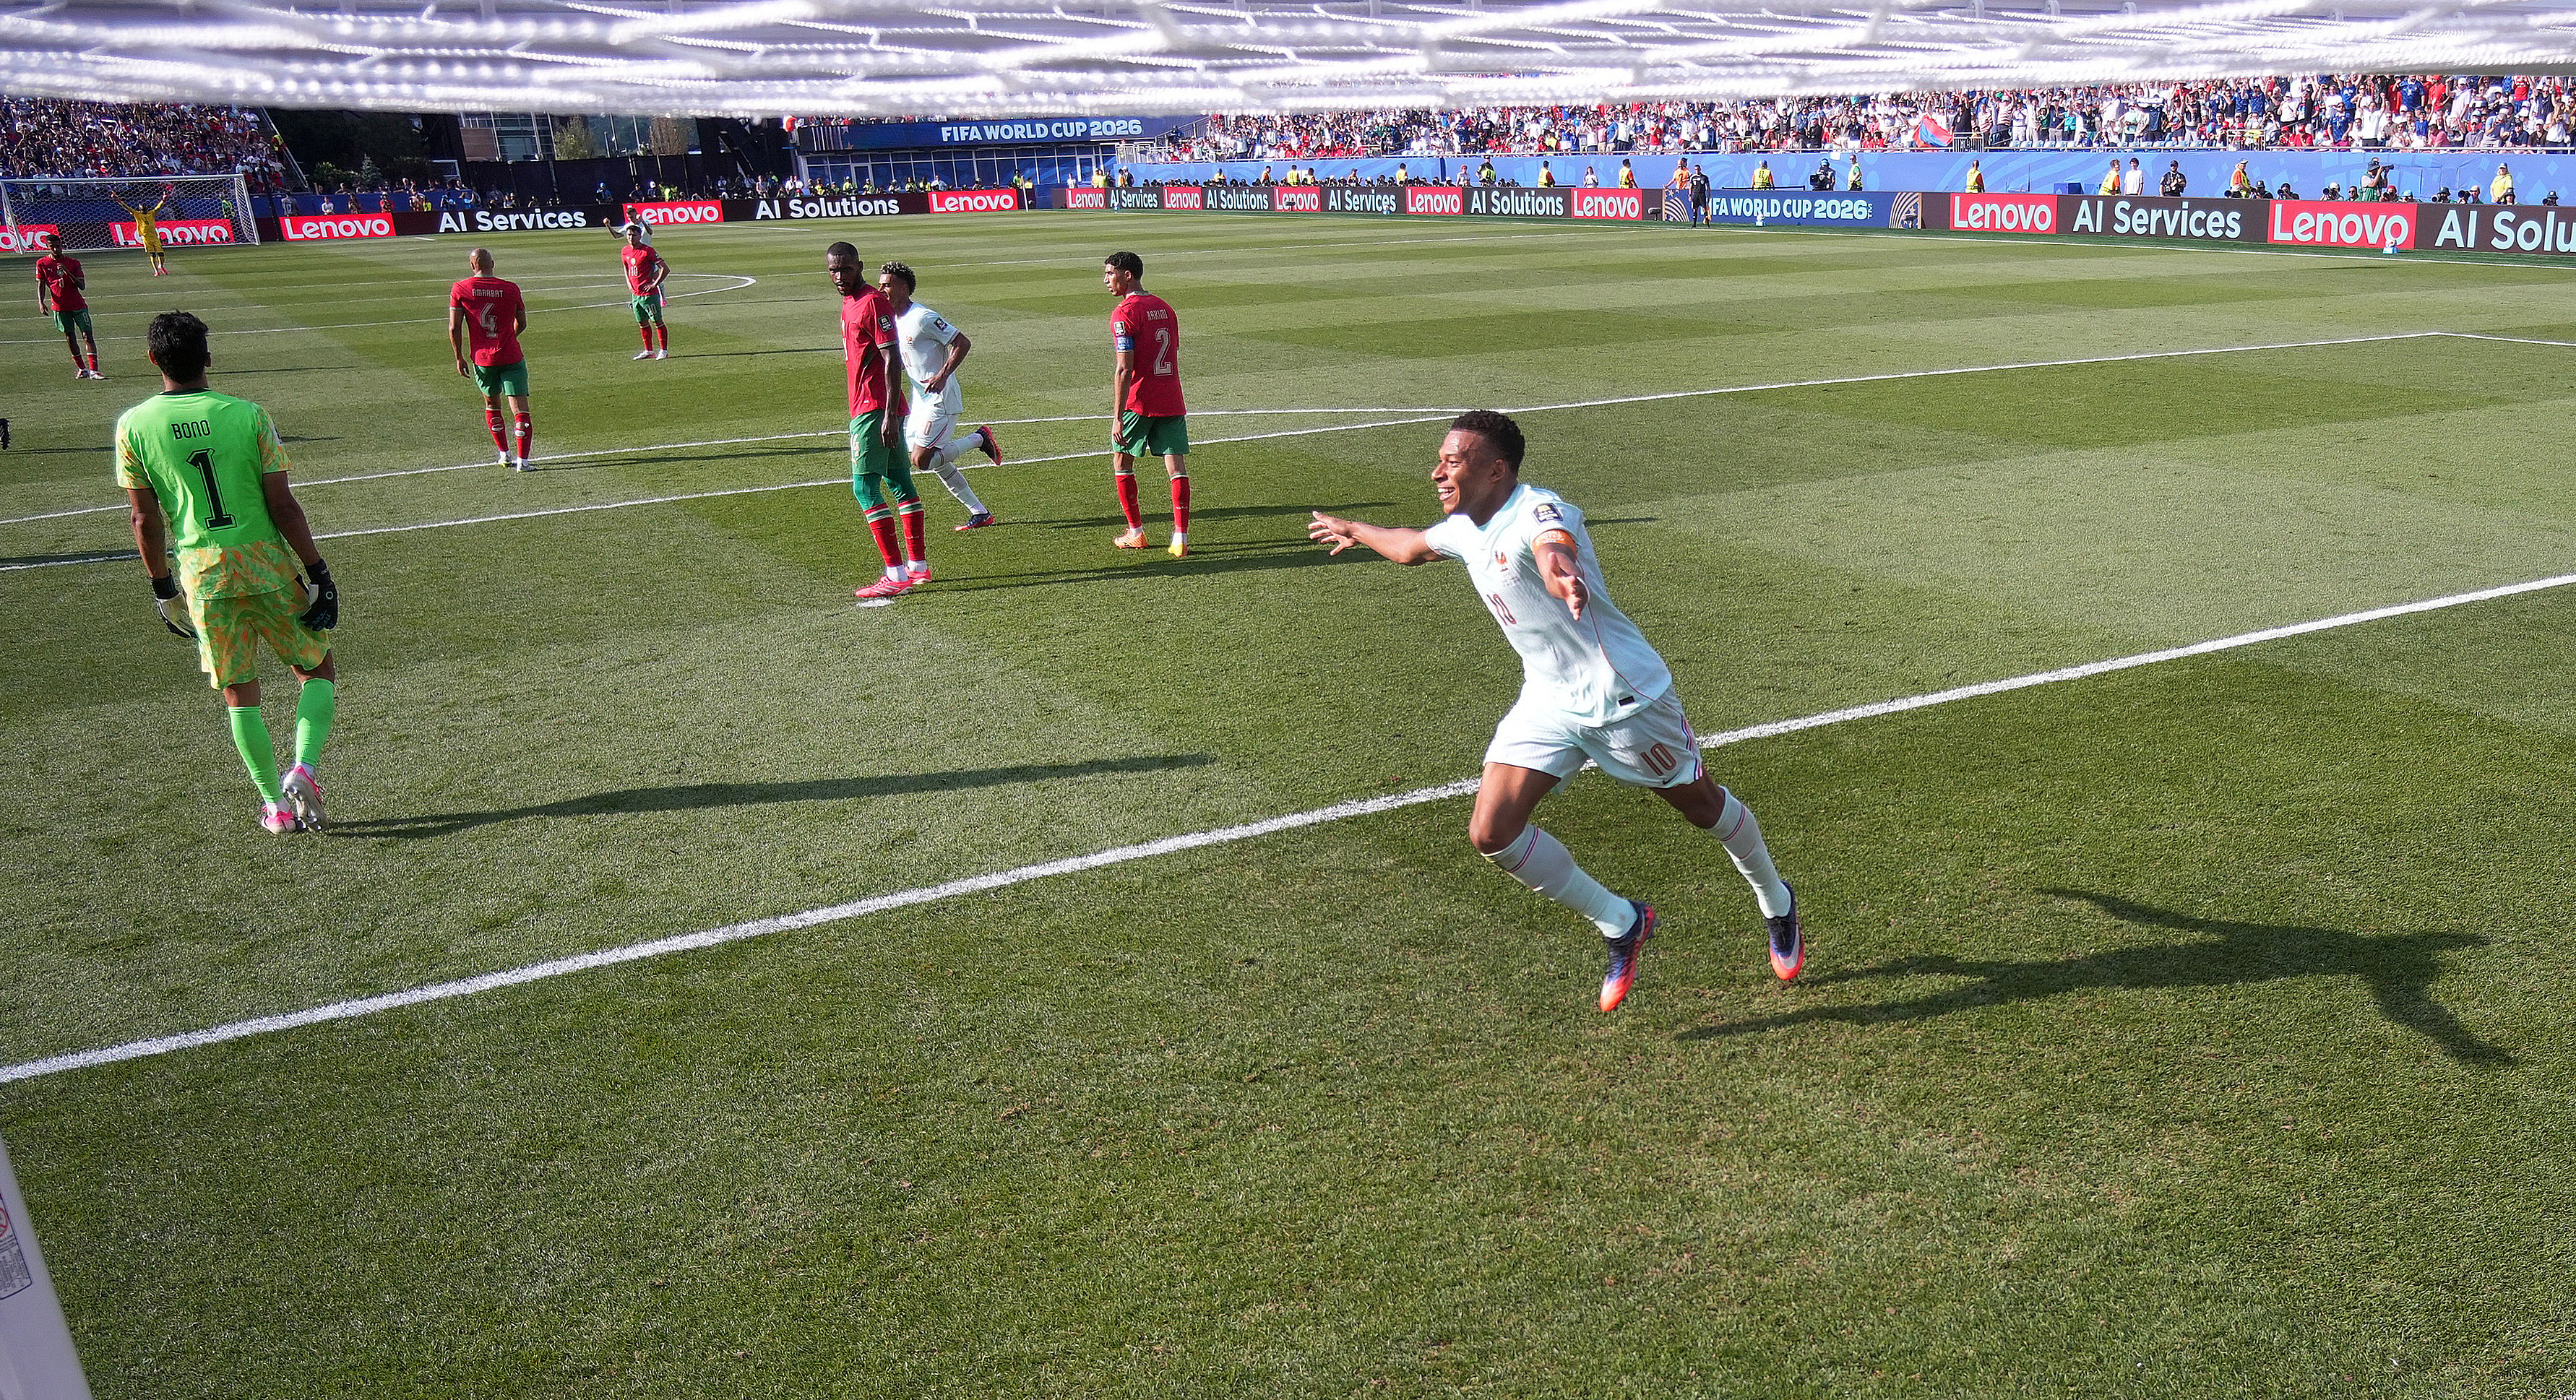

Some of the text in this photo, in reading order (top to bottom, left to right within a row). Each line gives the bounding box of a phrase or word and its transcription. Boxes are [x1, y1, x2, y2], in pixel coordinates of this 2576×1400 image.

[942, 118, 1143, 142] FIFA WORLD CUP 2026
[757, 196, 900, 220] AI Solutions
[932, 192, 1014, 212] Lenovo
[1068, 189, 1105, 208] Lenovo
[1121, 189, 1158, 208] Services
[1164, 188, 1200, 209] Lenovo
[1206, 188, 1270, 210] AI Solutions
[1275, 188, 1319, 210] Lenovo
[1328, 189, 1397, 212] AI Services
[1408, 189, 1461, 213] Lenovo
[1470, 190, 1564, 216] AI Solutions
[1573, 190, 1640, 218] Lenovo
[1731, 197, 1781, 218] WORLD
[1783, 199, 1812, 218] CUP
[1814, 199, 1868, 220] 2026
[439, 208, 587, 233] AI Services
[1954, 195, 2052, 232] Lenovo
[2072, 199, 2241, 239] AI Services
[2273, 203, 2409, 246] Lenovo
[283, 217, 391, 240] Lenovo
[2434, 209, 2576, 253] AI Solu
[471, 288, 504, 298] AMRABAT
[479, 302, 498, 340] 4
[1153, 327, 1173, 377] 2
[171, 419, 211, 441] BONO
[185, 447, 238, 532] 1
[1486, 594, 1517, 626] 10
[1640, 742, 1677, 777] 10
